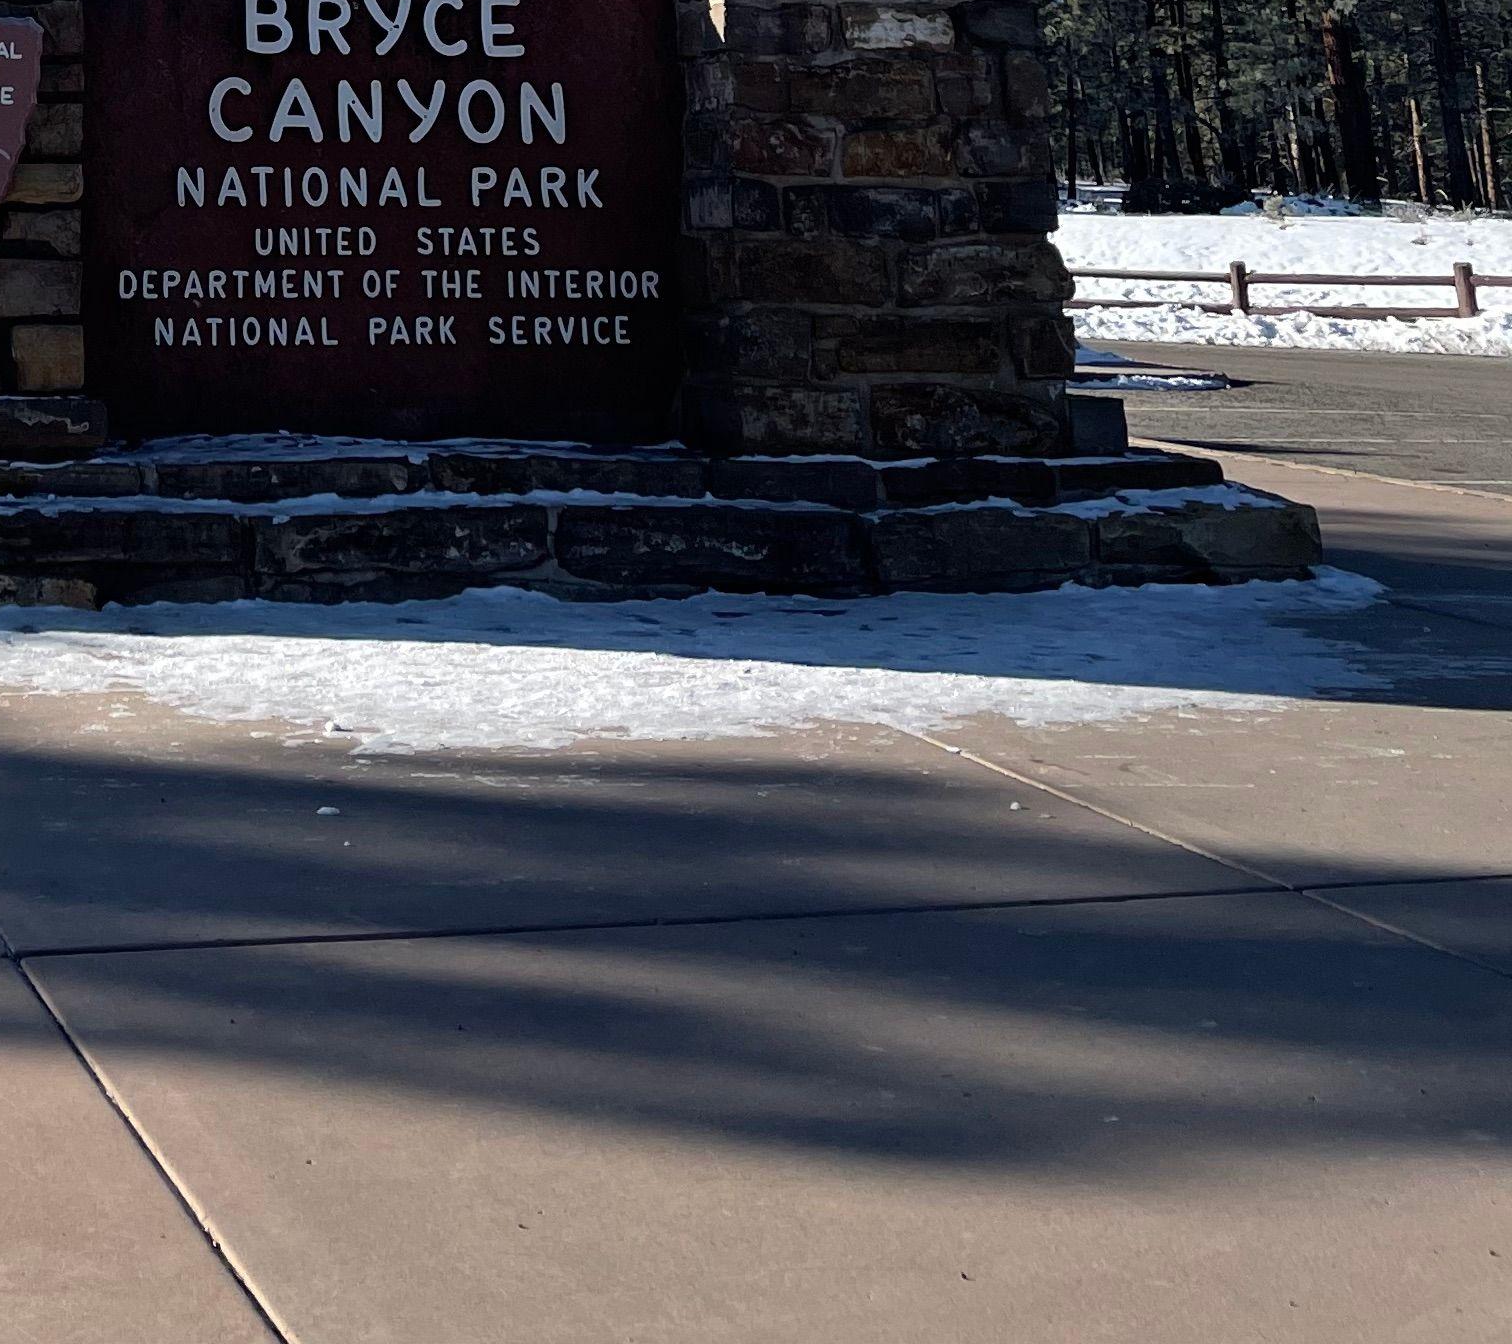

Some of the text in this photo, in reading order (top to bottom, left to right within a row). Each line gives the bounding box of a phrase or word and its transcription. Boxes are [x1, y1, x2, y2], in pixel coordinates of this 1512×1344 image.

[208, 76, 566, 145] CANYON
[177, 166, 603, 209] NATIONAL PARK
[254, 226, 541, 257] UNITED STATES
[118, 269, 660, 300] DEPARTMENT OF THE INTERIOR
[154, 315, 632, 347] NATIONAL PARK SERVICE
